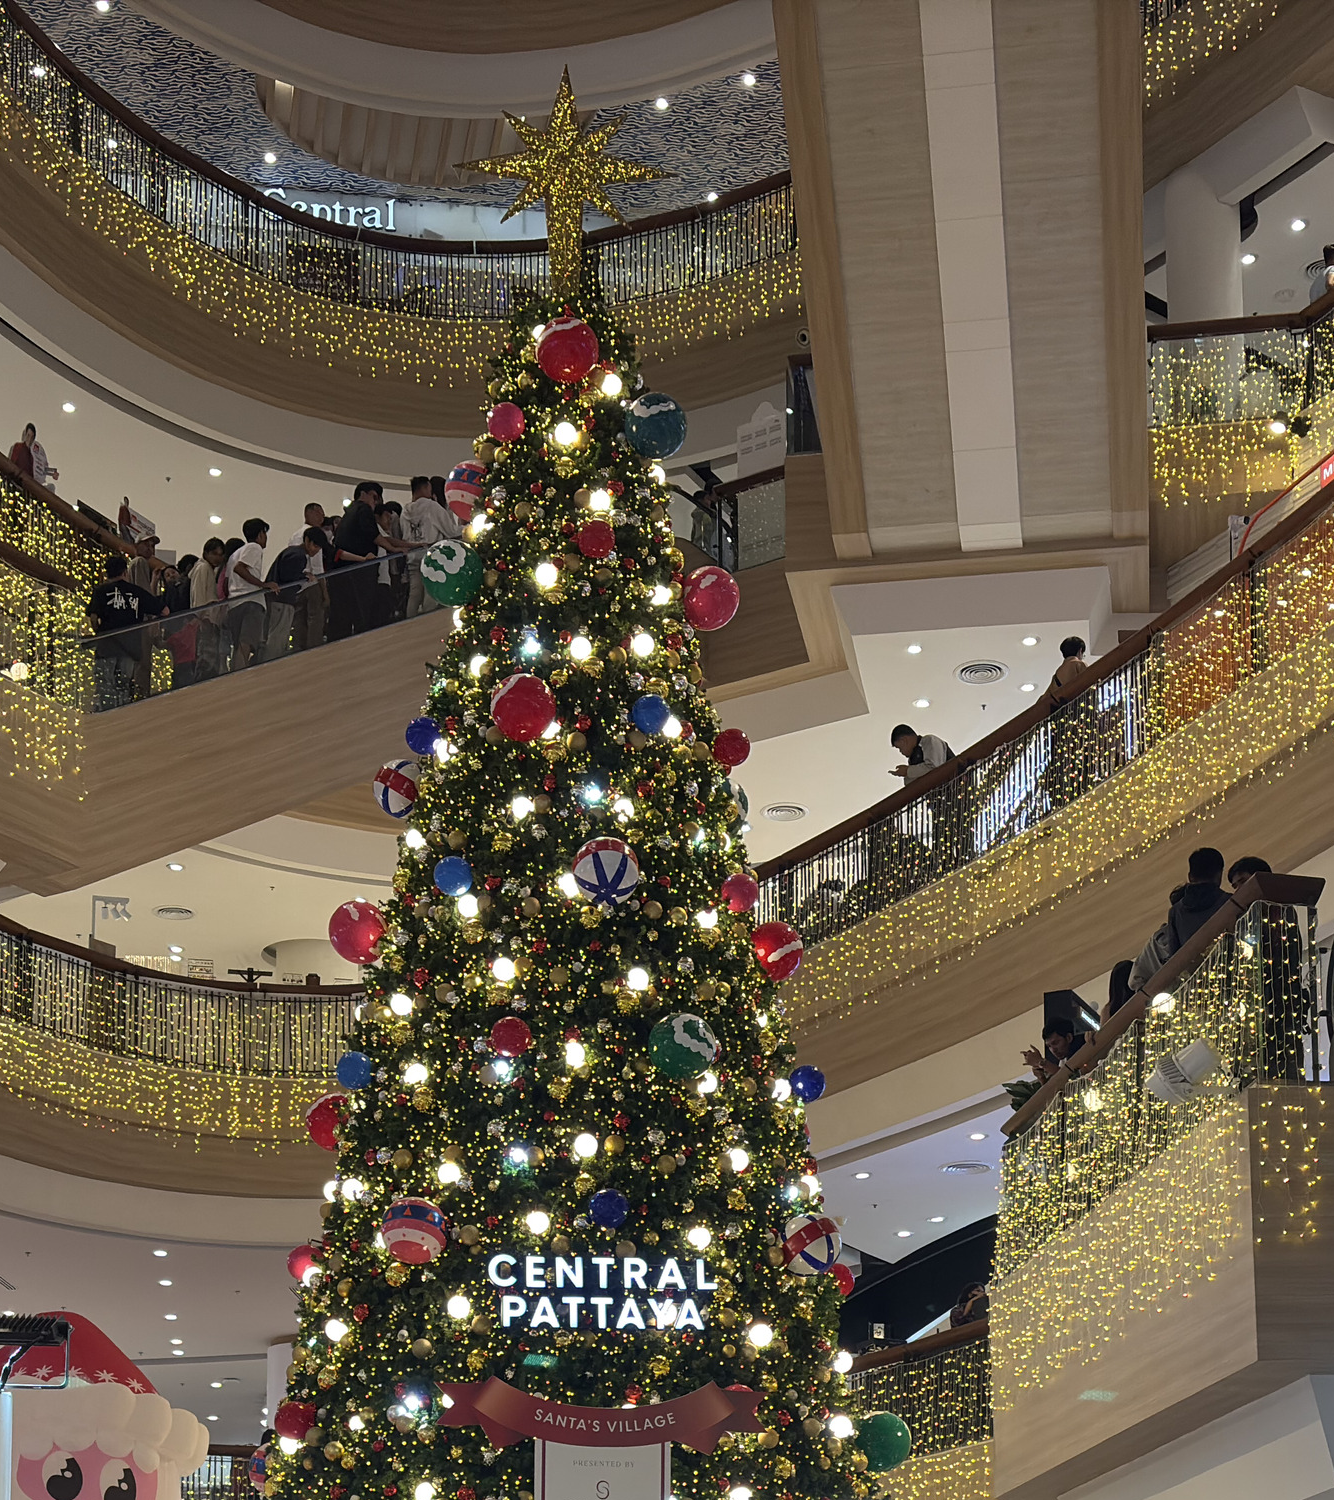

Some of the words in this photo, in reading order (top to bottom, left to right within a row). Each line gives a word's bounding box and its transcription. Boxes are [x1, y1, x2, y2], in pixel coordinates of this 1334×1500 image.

[488, 1253, 718, 1291] CENTRAL
[502, 1295, 705, 1331] PATTAYA
[534, 1408, 601, 1433] SANTA'S
[606, 1412, 676, 1433] VILLAGE
[572, 1459, 622, 1468] PRESENTED
[624, 1460, 635, 1468] BY
